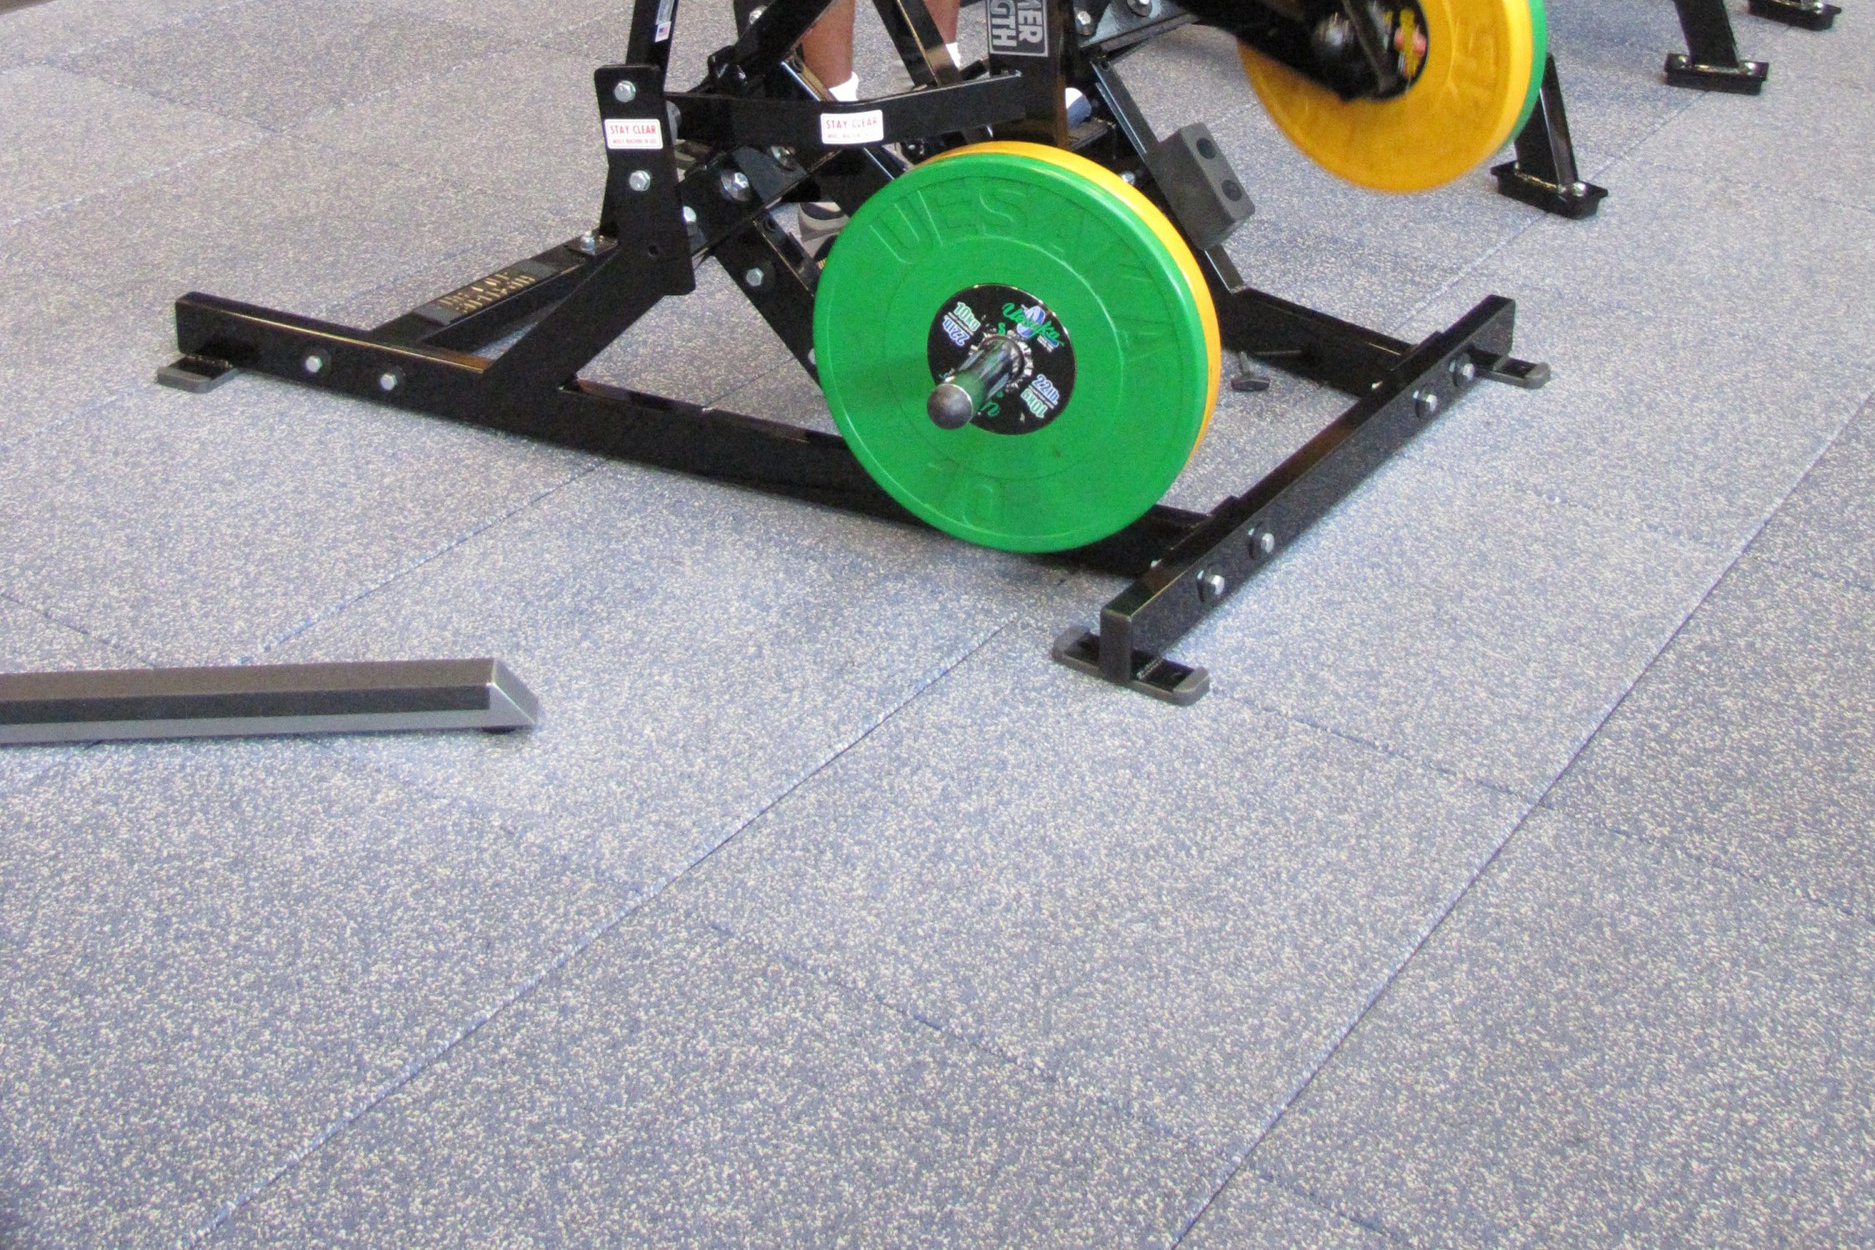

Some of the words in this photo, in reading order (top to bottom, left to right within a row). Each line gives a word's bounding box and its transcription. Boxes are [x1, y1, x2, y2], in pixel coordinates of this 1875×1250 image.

[609, 124, 630, 135] STAY
[632, 124, 657, 135] CLEAR
[825, 119, 848, 130] STAY
[952, 301, 982, 332] 10kg
